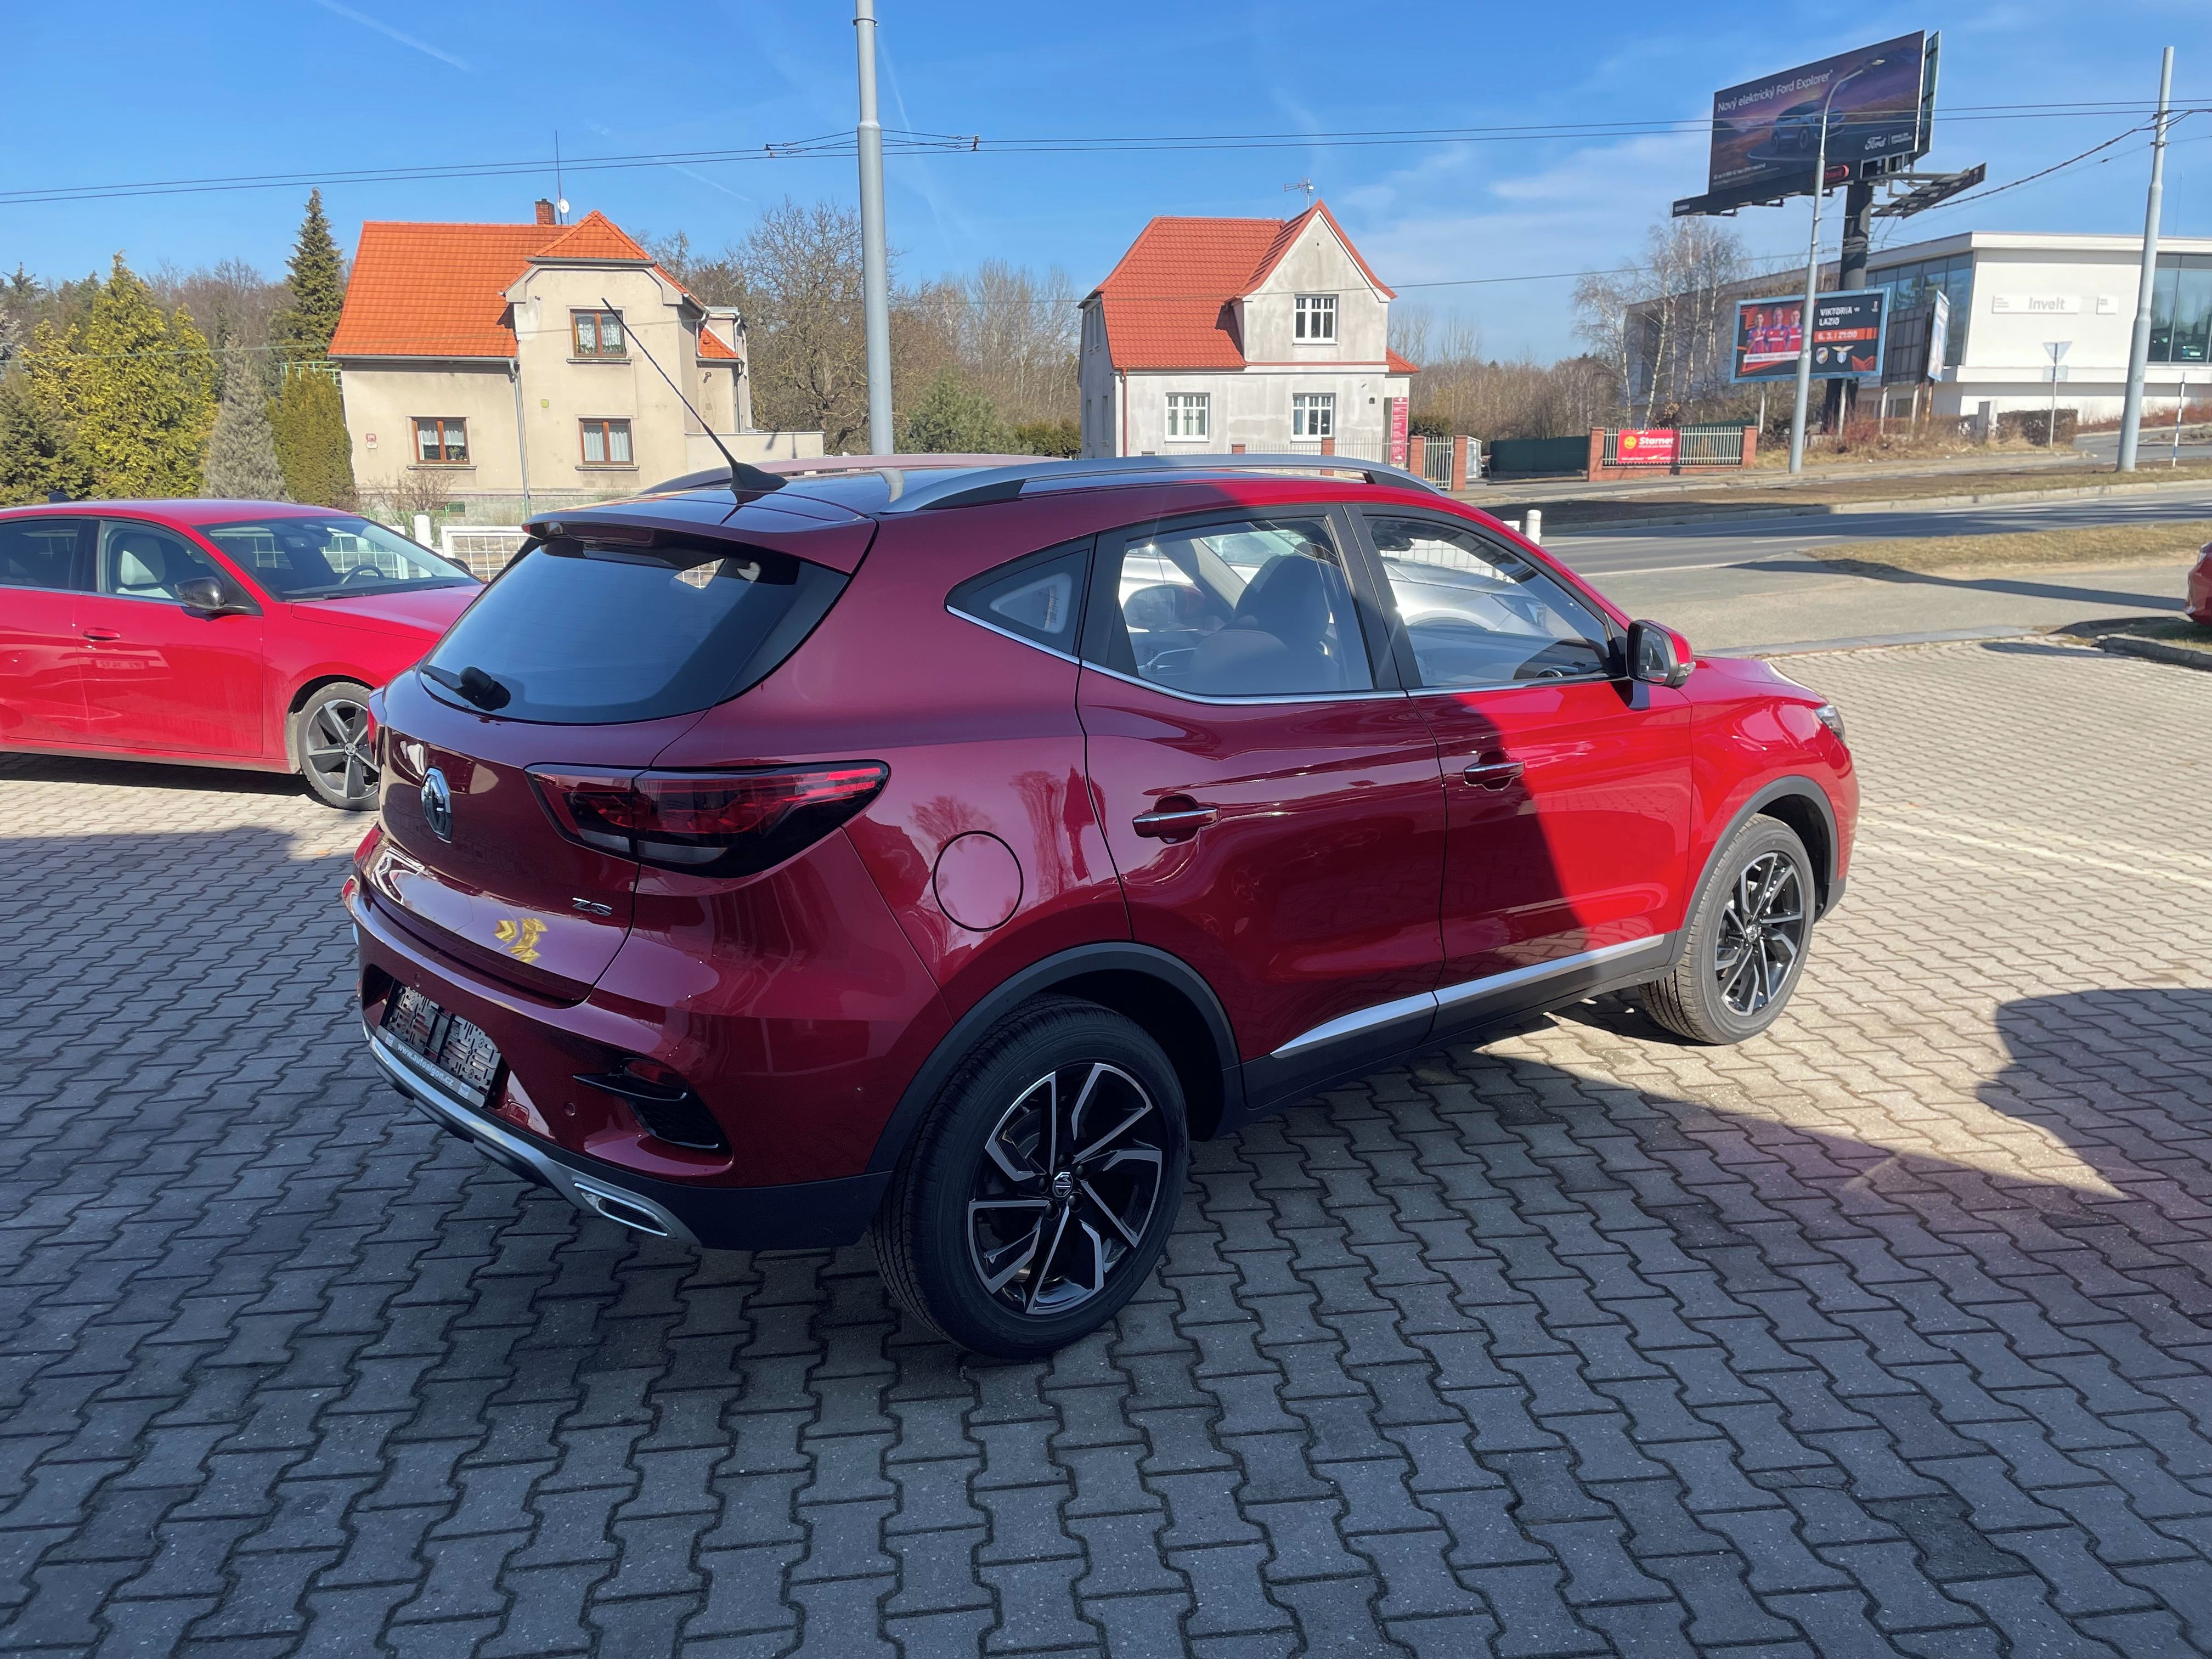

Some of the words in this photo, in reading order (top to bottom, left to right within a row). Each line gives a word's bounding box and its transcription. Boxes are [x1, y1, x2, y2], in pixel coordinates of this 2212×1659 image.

[1717, 98, 1737, 112] Nový
[1738, 86, 1775, 106] elektrický
[1776, 80, 1795, 95] Ford
[2028, 297, 2066, 310] Invelt
[1819, 306, 1853, 316] VIKTORIA
[1819, 317, 1840, 326] LAZIO
[1639, 436, 1674, 445] Starnet
[572, 897, 612, 917] ZS
[397, 1043, 454, 1086] www.autoalgon.cz
